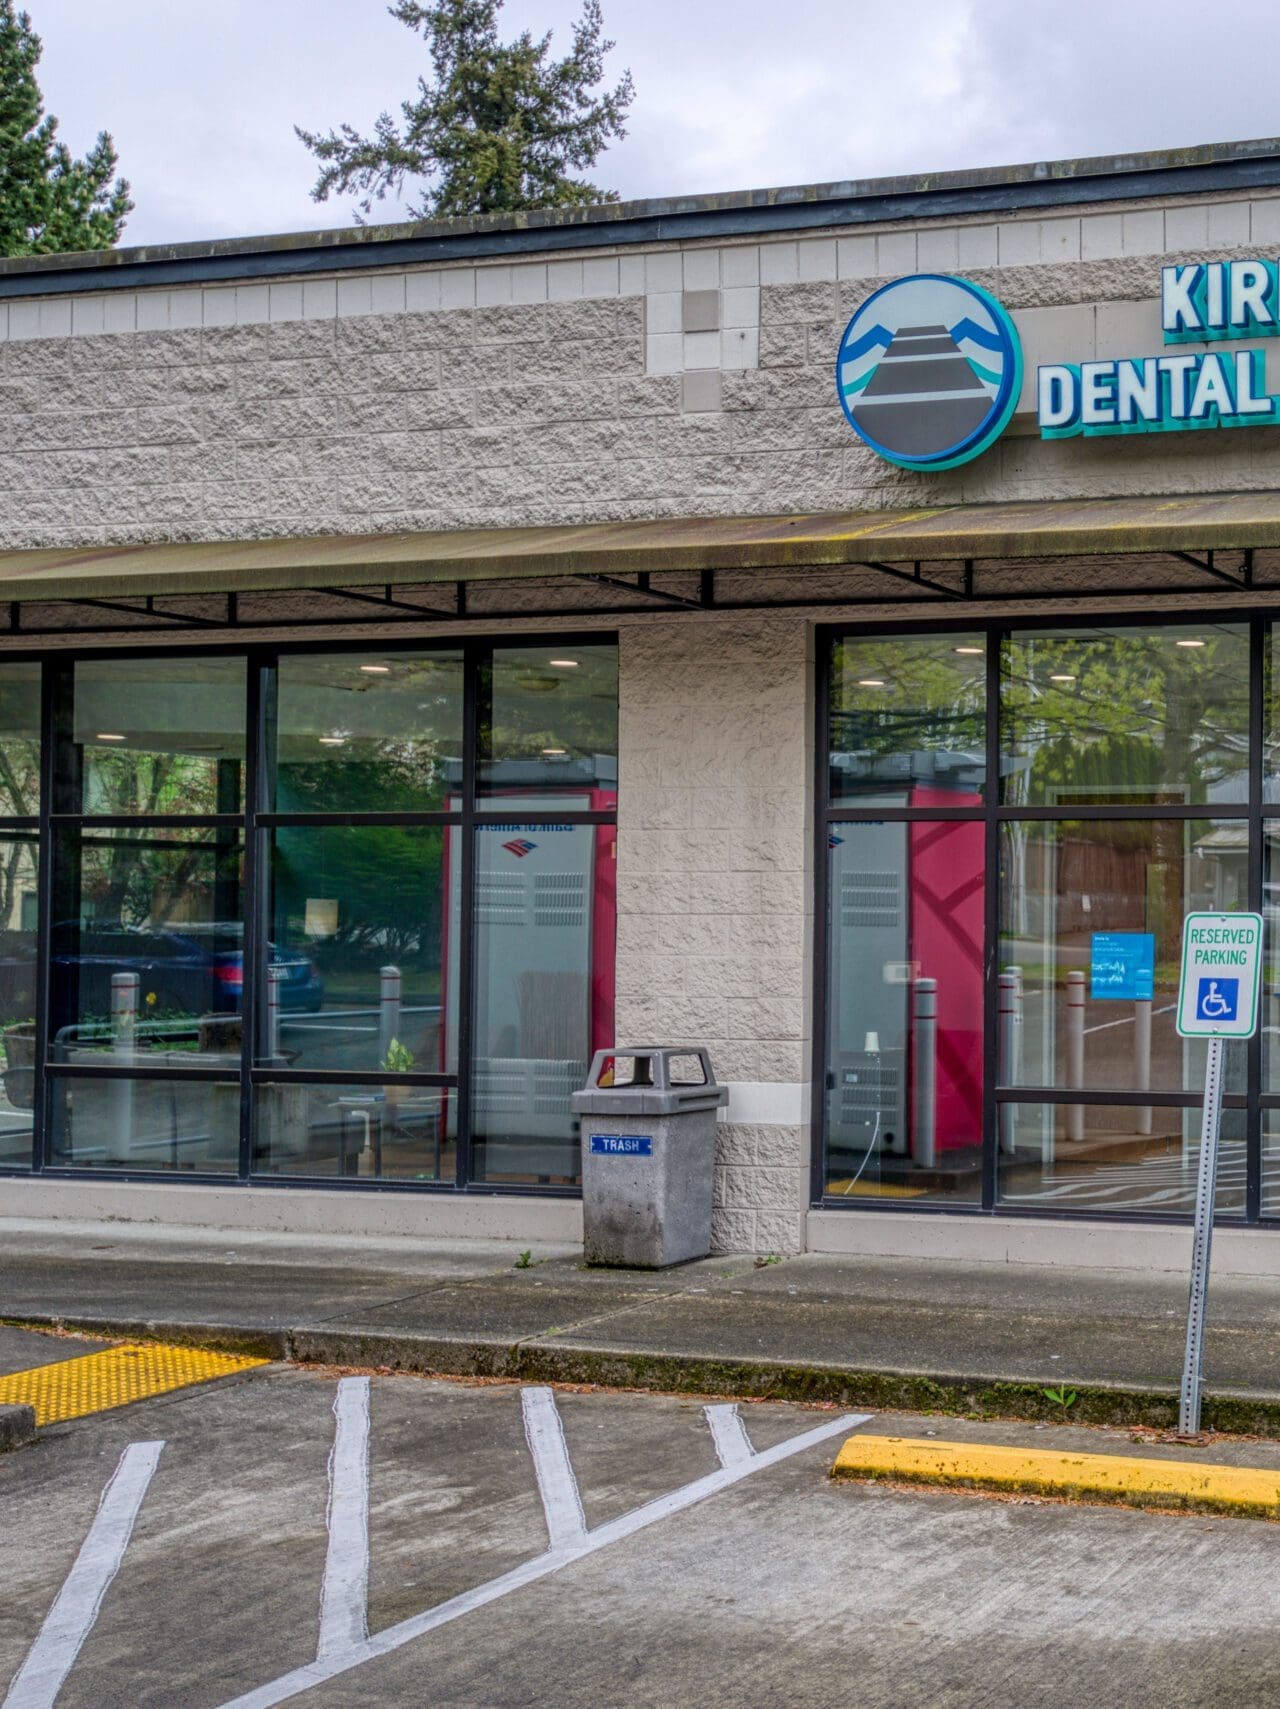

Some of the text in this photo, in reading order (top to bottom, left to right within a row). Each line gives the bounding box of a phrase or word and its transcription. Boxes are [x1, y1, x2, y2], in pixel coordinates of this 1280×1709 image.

[1037, 350, 1276, 429] DENTAL
[1190, 928, 1255, 945] RESERVED
[1194, 949, 1248, 966] PARKING
[602, 1138, 640, 1152] TRASH
